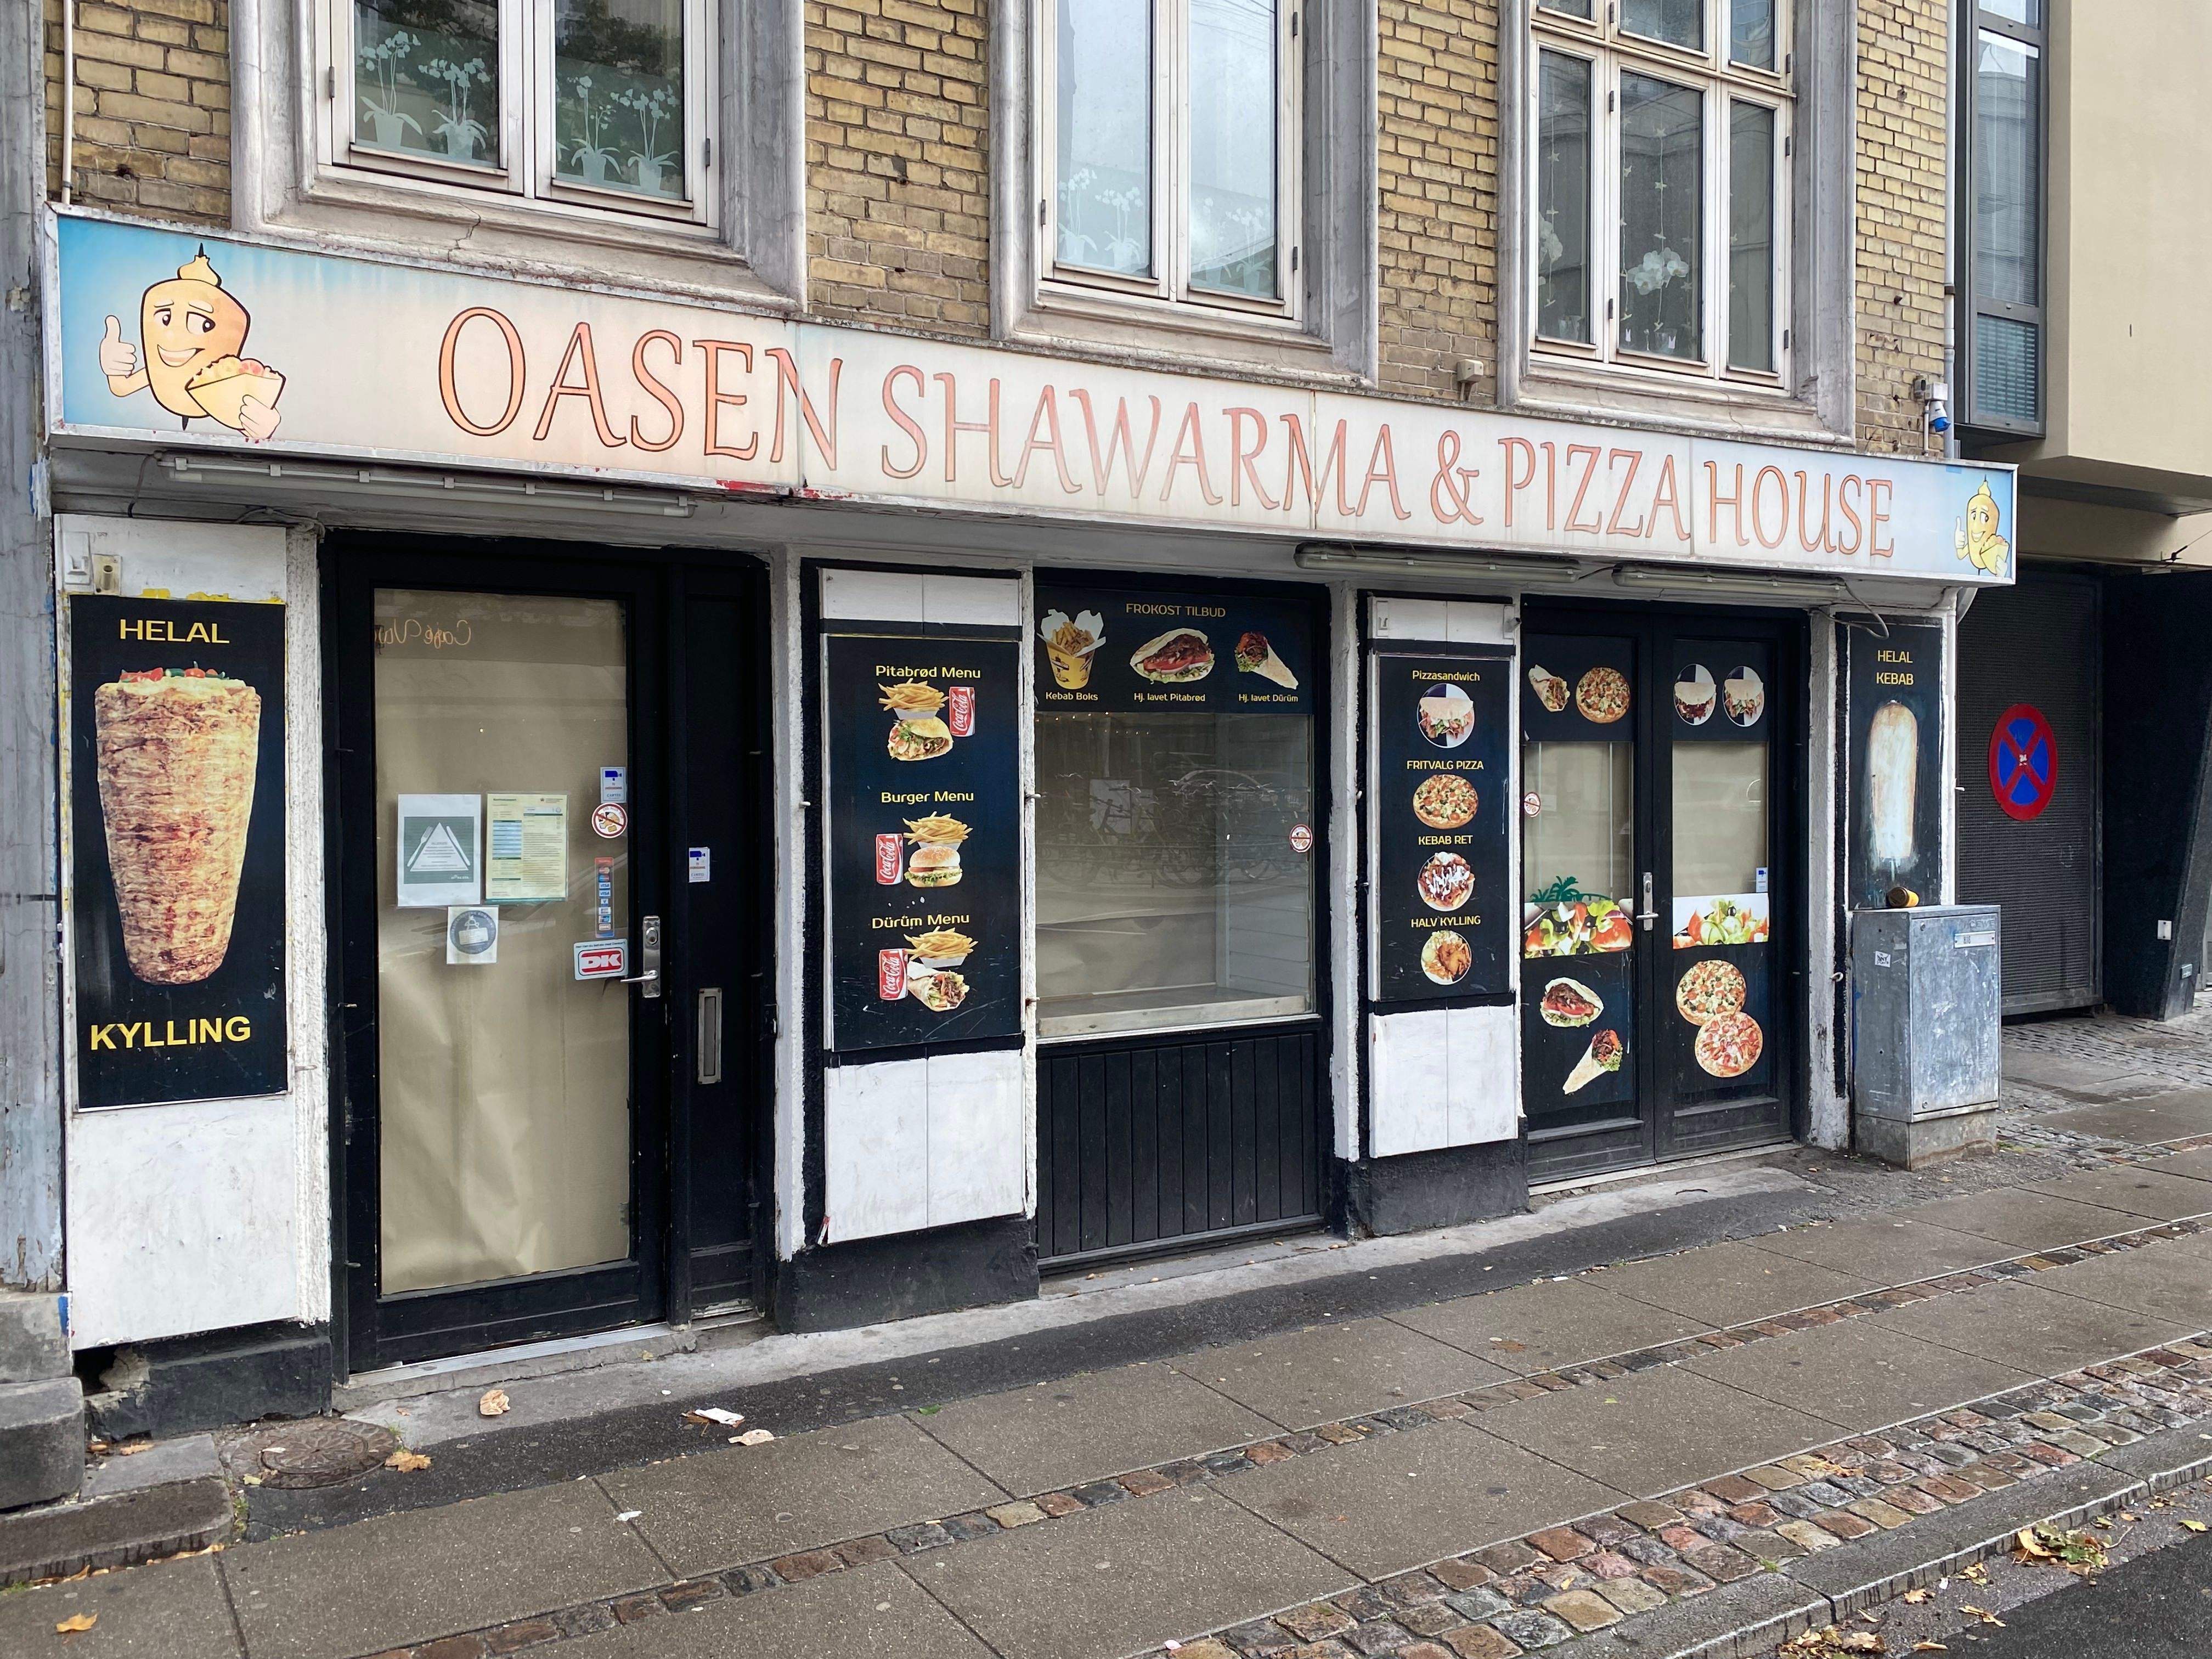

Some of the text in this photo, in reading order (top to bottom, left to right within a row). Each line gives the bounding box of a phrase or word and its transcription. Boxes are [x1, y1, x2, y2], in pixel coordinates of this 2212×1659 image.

[439, 307, 1895, 557] OASEN SHAWARMA & PIZZA HOUSE
[1126, 603, 1226, 618] FROKOST TILBUD
[120, 619, 230, 644] HELAL
[1877, 650, 1914, 663] HELAL
[876, 665, 981, 678] Pitabrød Menu
[1412, 670, 1480, 681] Pizzasandwich
[1876, 672, 1914, 685] KEBAB
[1046, 692, 1098, 702] Kebab Boks
[1134, 693, 1206, 702] Hj. lavet Pitabrød
[1239, 693, 1299, 703] Hj. lavet Dürüm
[1407, 760, 1484, 770] FRITVALG PIZZA
[881, 791, 974, 805] Burger Menu
[1419, 835, 1473, 845] KEBAB RET
[872, 913, 969, 929] Dürüm Menu
[1410, 915, 1481, 928] HALV KYLLING
[579, 953, 622, 969] DK
[91, 1016, 251, 1051] KYLLING
